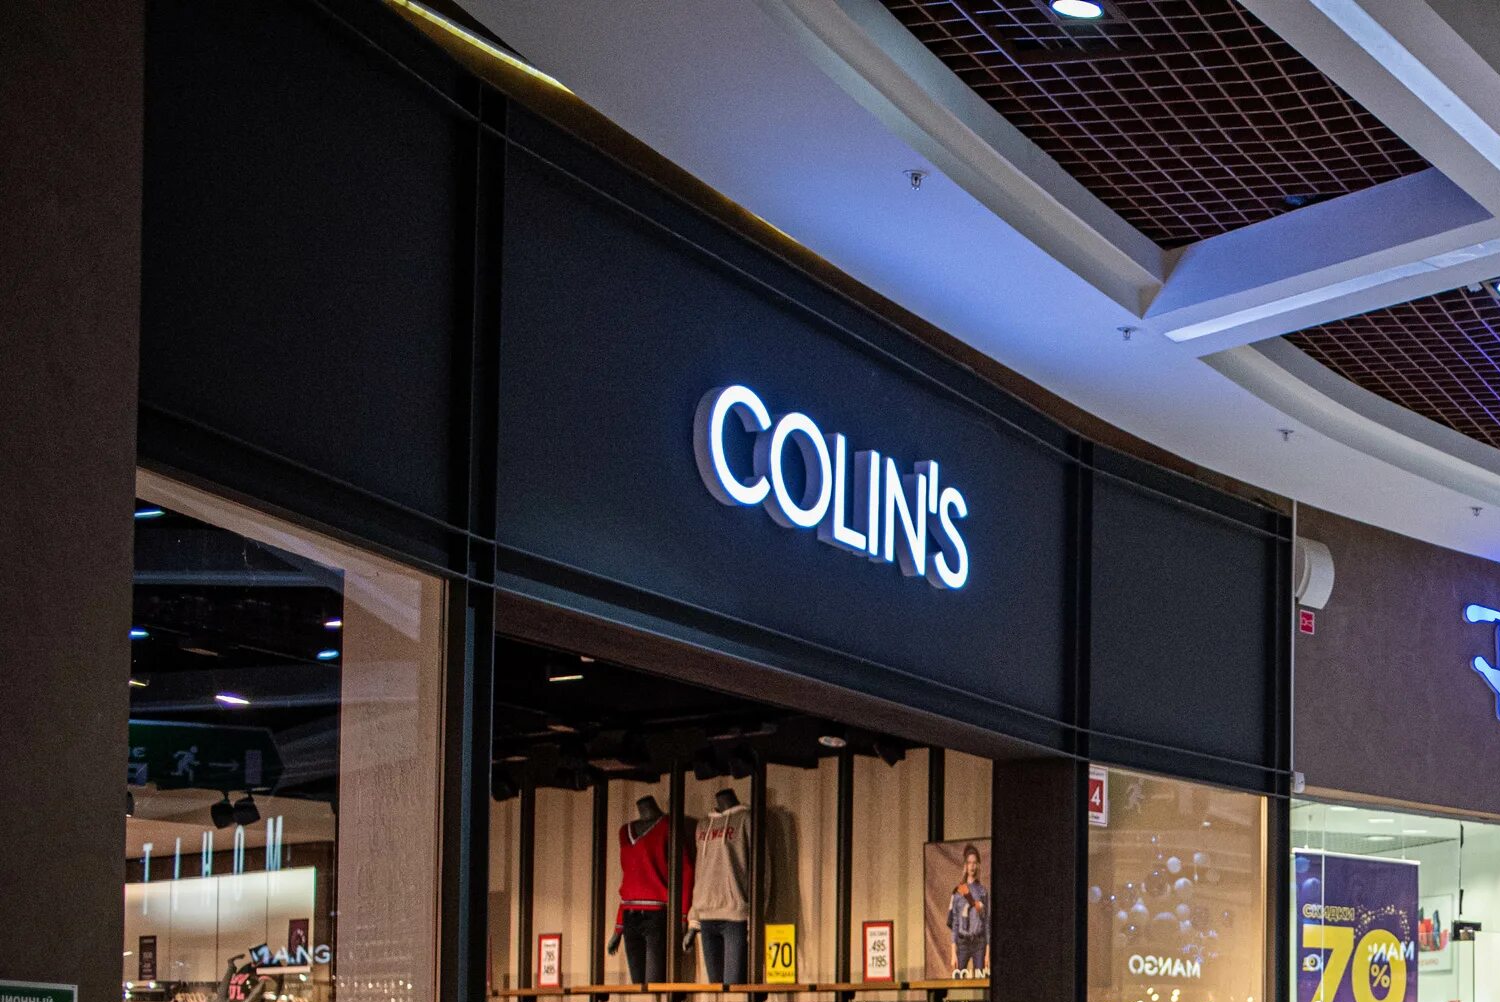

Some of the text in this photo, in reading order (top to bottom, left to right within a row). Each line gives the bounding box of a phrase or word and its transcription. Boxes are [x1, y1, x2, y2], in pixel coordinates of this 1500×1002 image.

[694, 384, 970, 590] COLIN'S
[1302, 903, 1355, 922] СКИДКИ
[770, 942, 793, 968] 70
